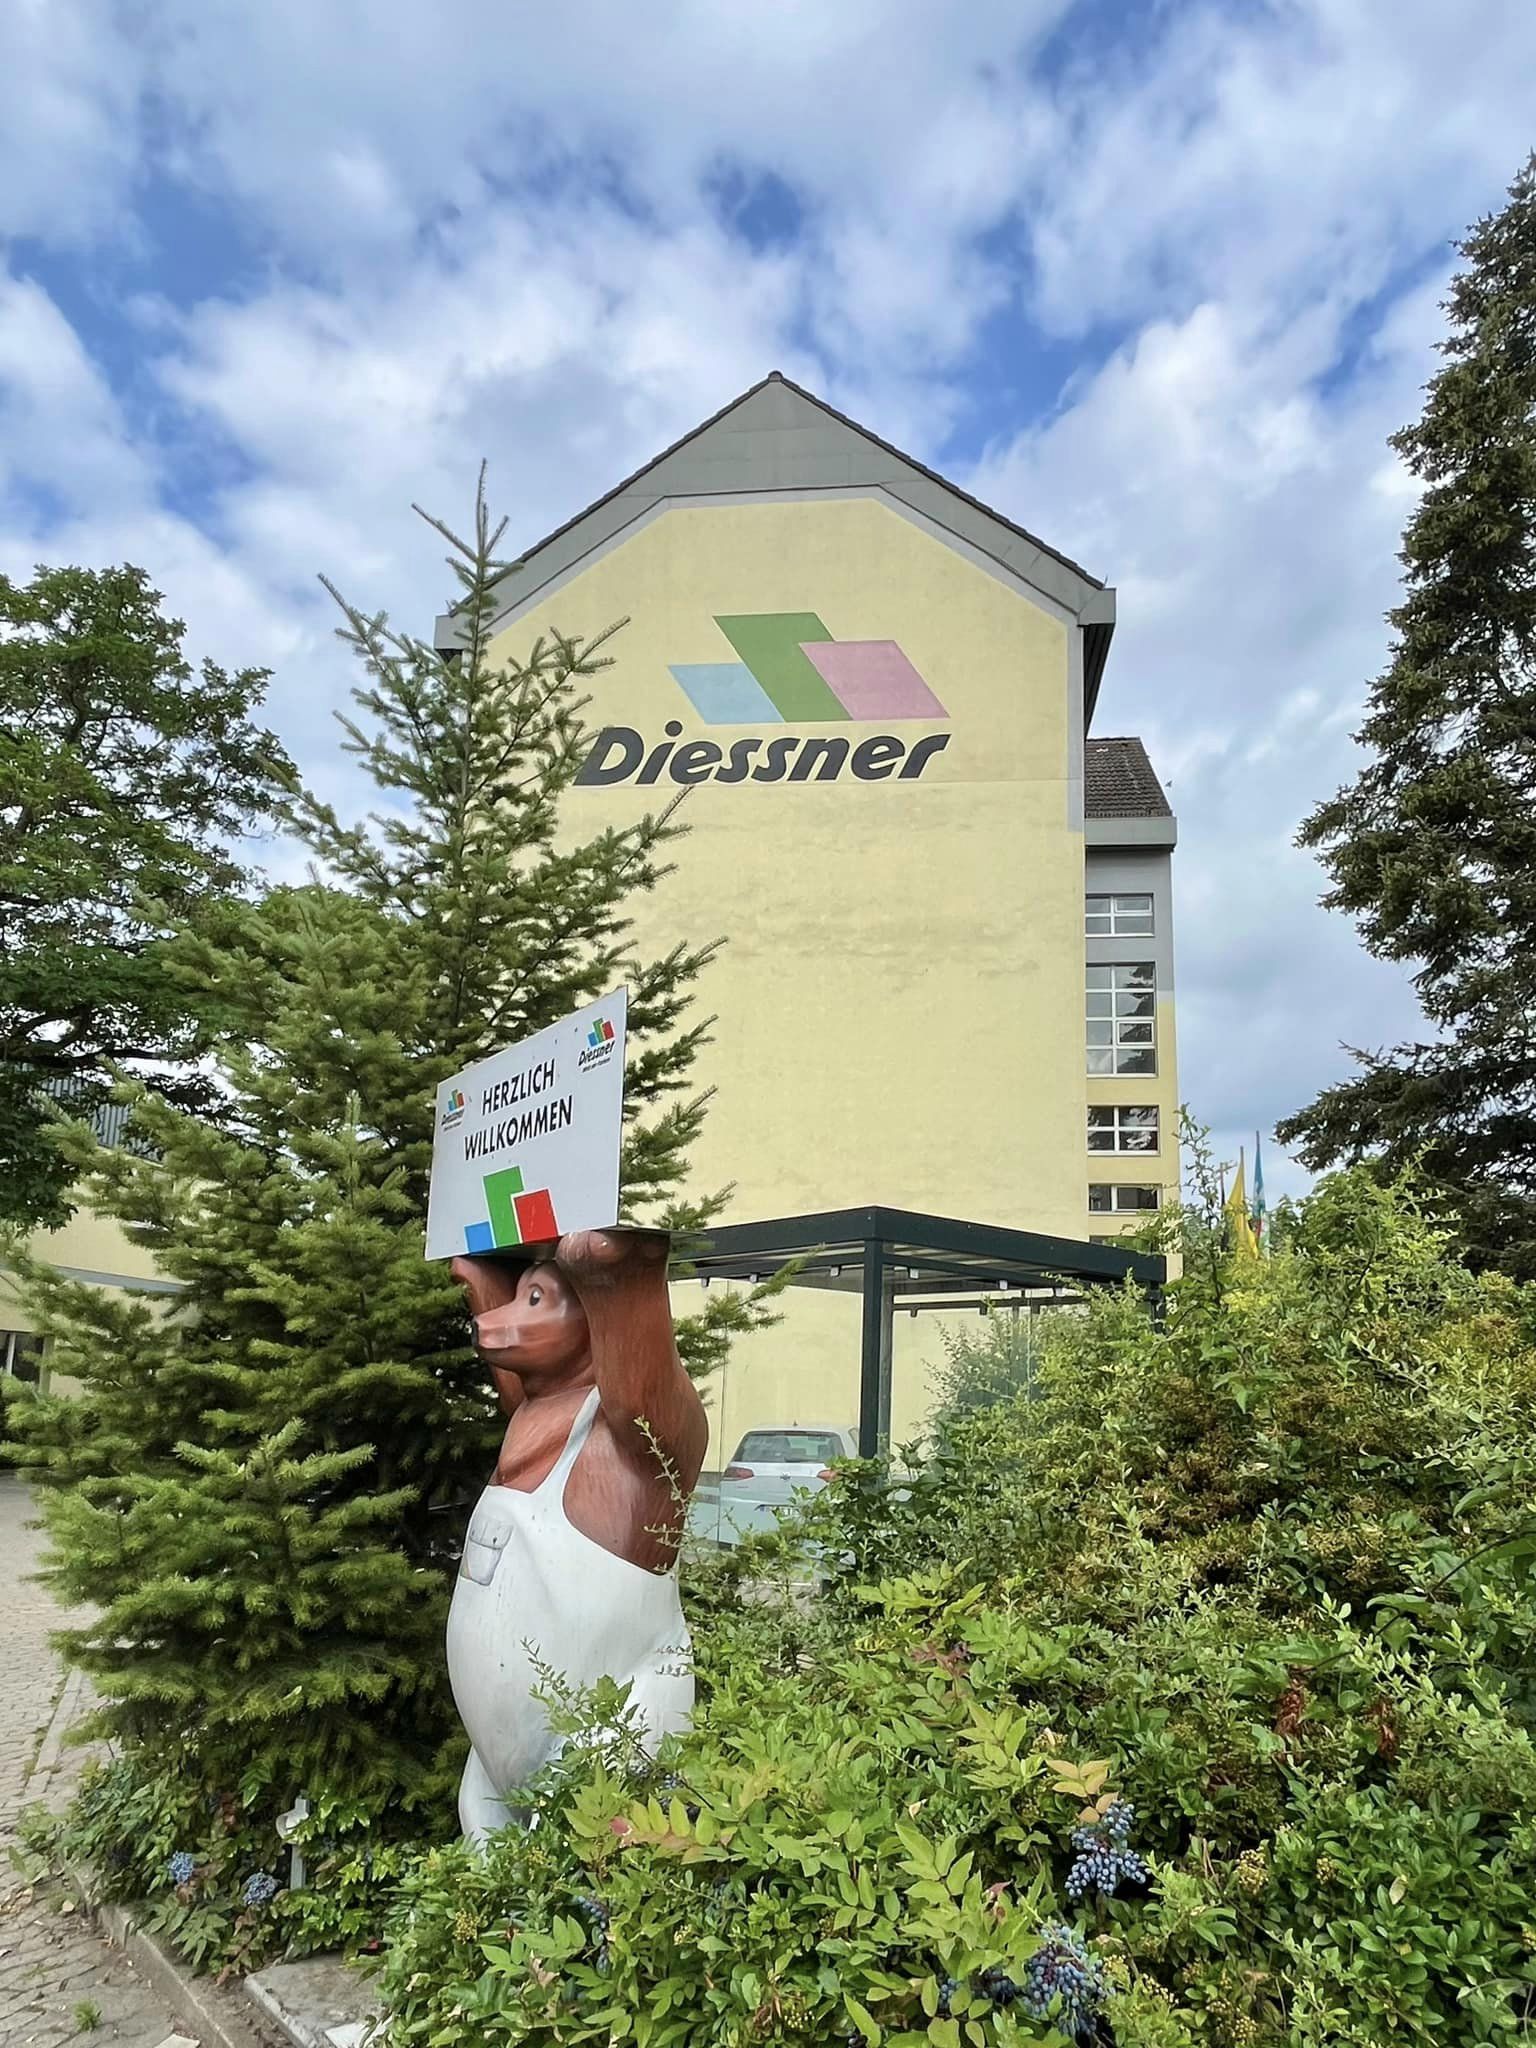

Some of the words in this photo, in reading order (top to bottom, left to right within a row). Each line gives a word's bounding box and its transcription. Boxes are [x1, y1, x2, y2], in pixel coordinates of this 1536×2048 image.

[573, 720, 951, 786] Diessner
[482, 1058, 555, 1115] HERZLICH
[464, 1095, 573, 1161] WILLKOMMEN
